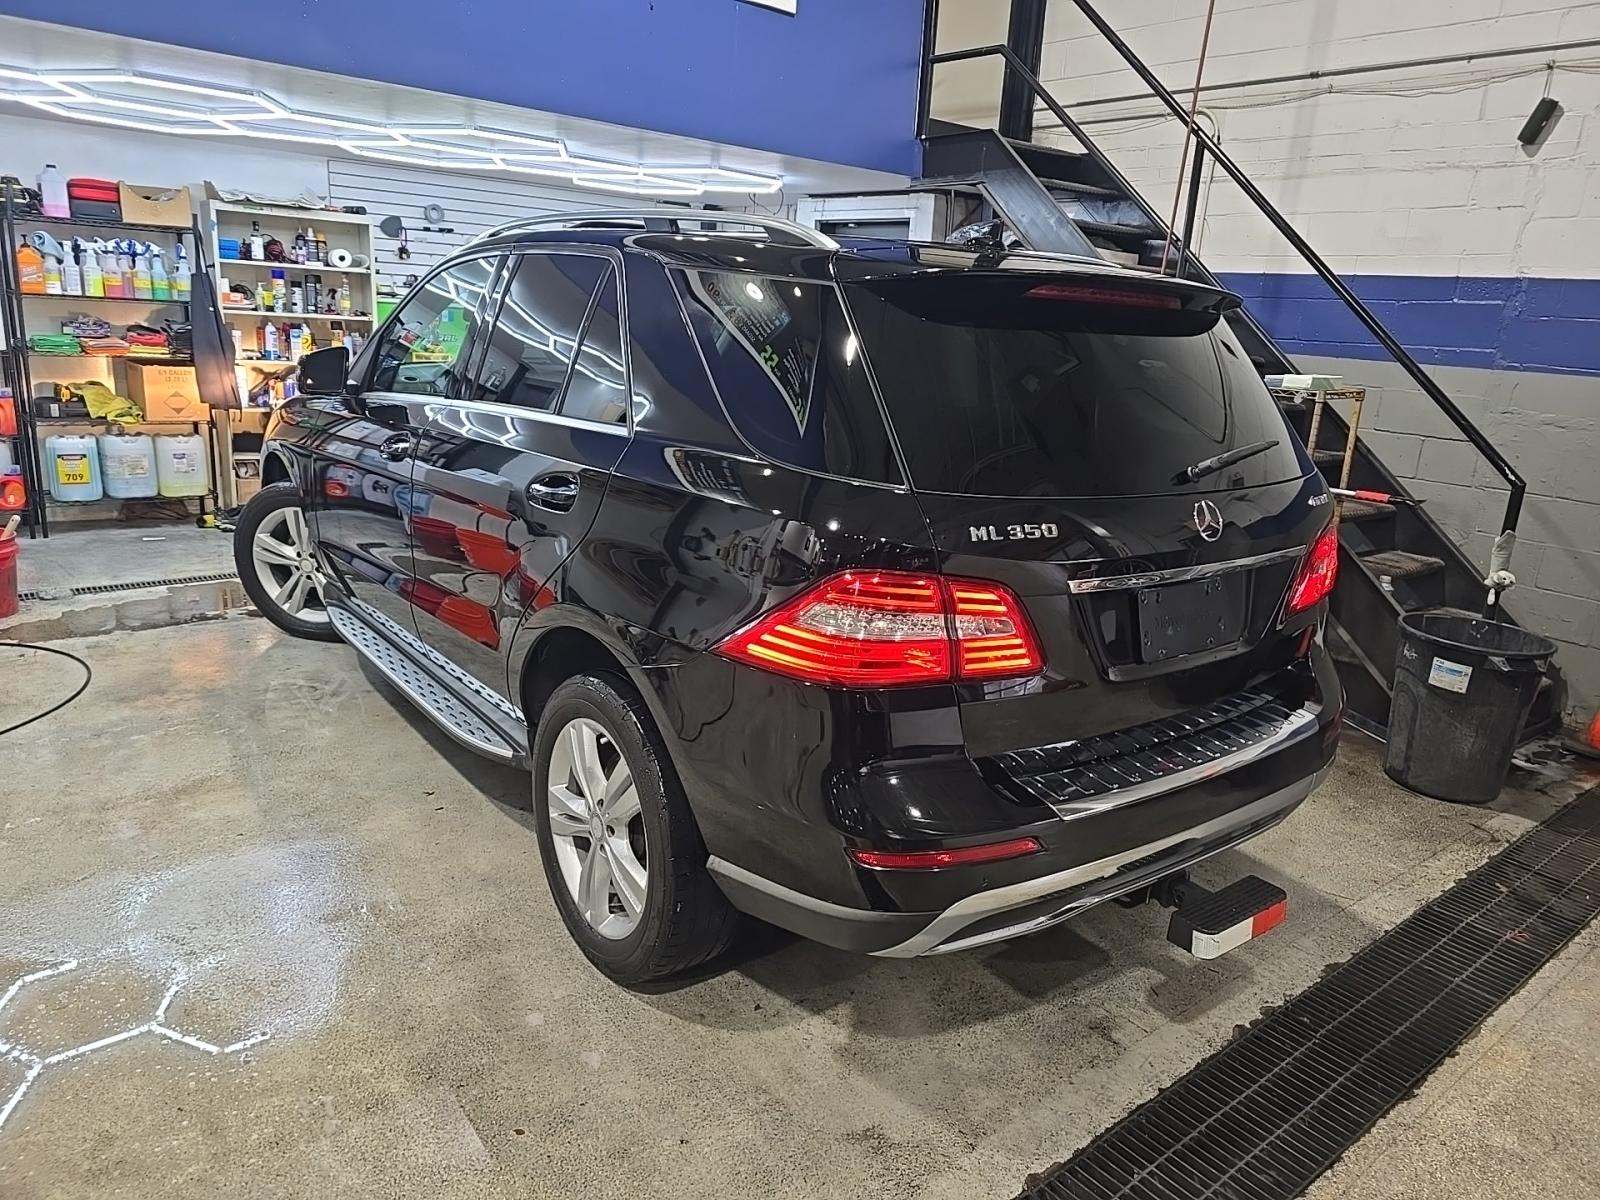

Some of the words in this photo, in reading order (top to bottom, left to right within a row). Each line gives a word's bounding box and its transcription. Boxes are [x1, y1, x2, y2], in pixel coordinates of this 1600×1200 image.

[65, 473, 84, 482] 709
[968, 525, 1004, 541] ML
[1007, 523, 1059, 540] 350
